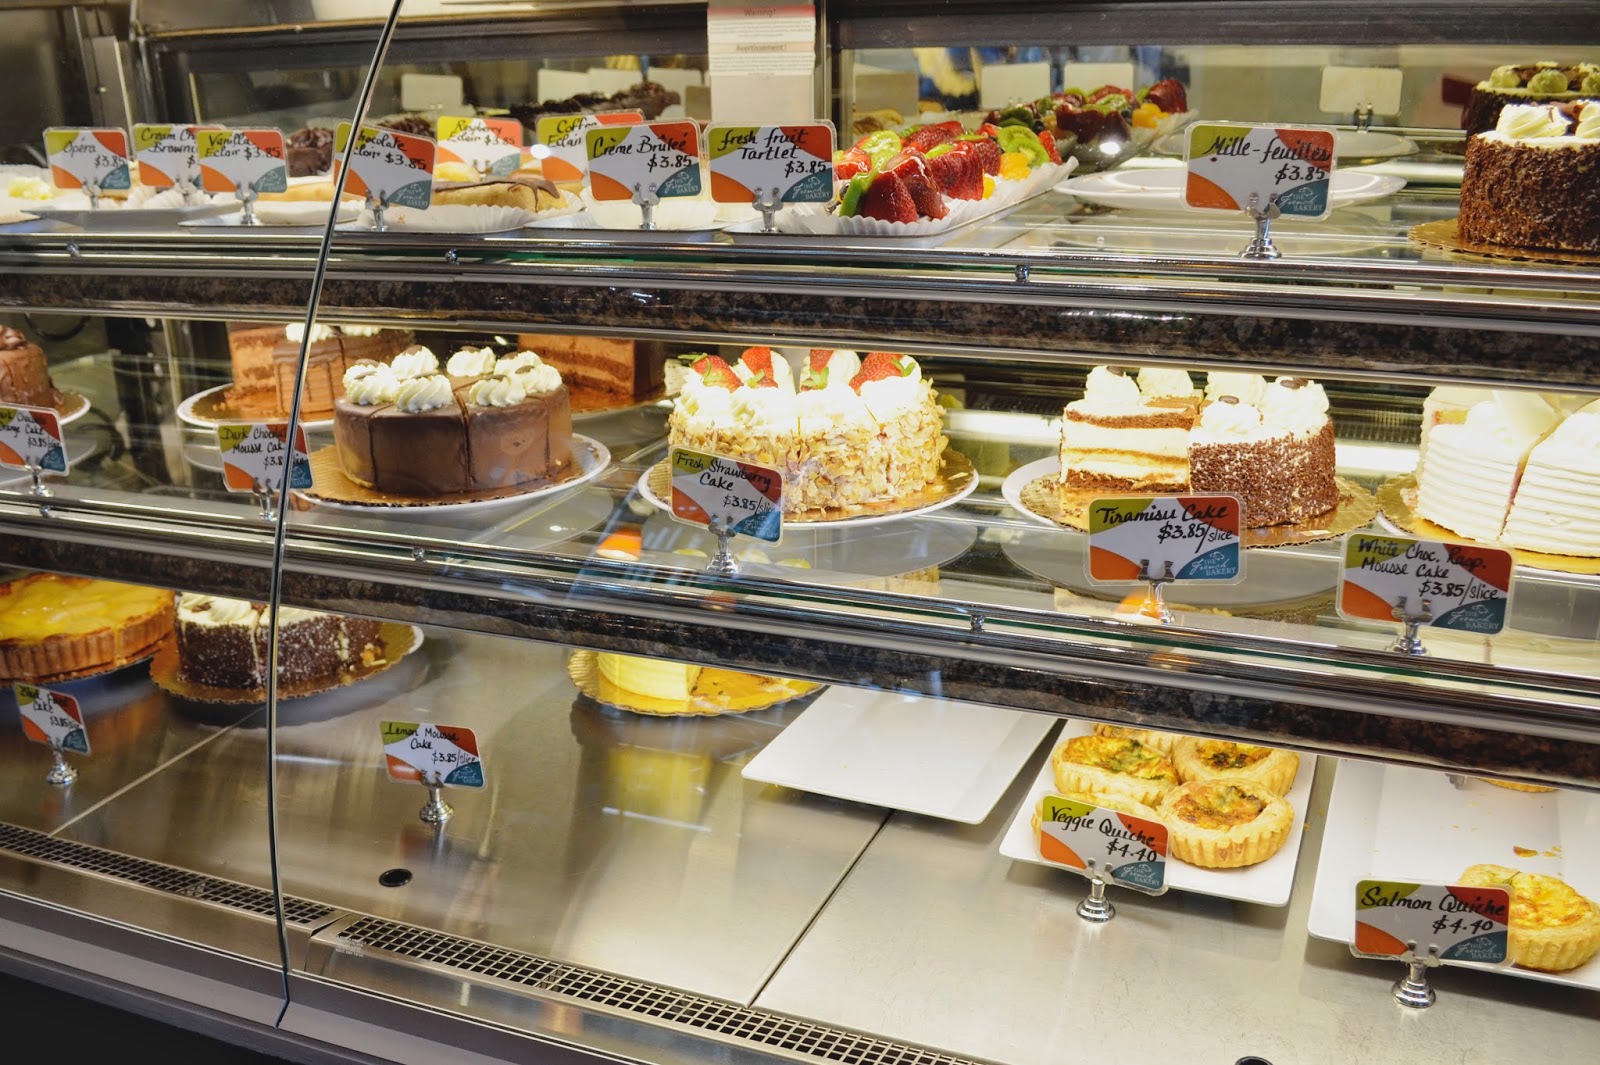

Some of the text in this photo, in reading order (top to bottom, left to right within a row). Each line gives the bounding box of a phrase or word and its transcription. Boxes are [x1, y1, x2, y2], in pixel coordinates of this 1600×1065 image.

[744, 8, 776, 17] Warning!
[141, 128, 176, 141] Cream
[208, 132, 251, 147] Vanilla
[359, 130, 406, 151] hocolate
[149, 142, 196, 153] Browni
[244, 146, 281, 160] $3.85
[593, 136, 633, 159] Crème
[737, 145, 801, 160] Tartlet
[384, 152, 426, 170] $3.85
[647, 153, 693, 173] $3.85
[784, 160, 827, 178] $3.85
[1275, 163, 1329, 185] $3.85
[805, 191, 830, 199] BAKERY
[1293, 204, 1323, 212] BAKERY
[267, 442, 285, 453] Cak
[675, 451, 771, 493] Fresh Strawberry
[699, 472, 734, 491] Cake
[1096, 503, 1228, 524] Tiramisu Cake
[1359, 539, 1400, 557] White
[1406, 544, 1440, 563] Choc.
[1205, 567, 1236, 576] BAKERY
[1361, 557, 1450, 579] Mousse Cake
[410, 738, 433, 750] Cake
[1052, 806, 1155, 847] Veggie Quiche
[1106, 838, 1157, 862] $4.40
[1361, 886, 1506, 914] Salmon Quiche
[1432, 915, 1494, 934] $4.40
